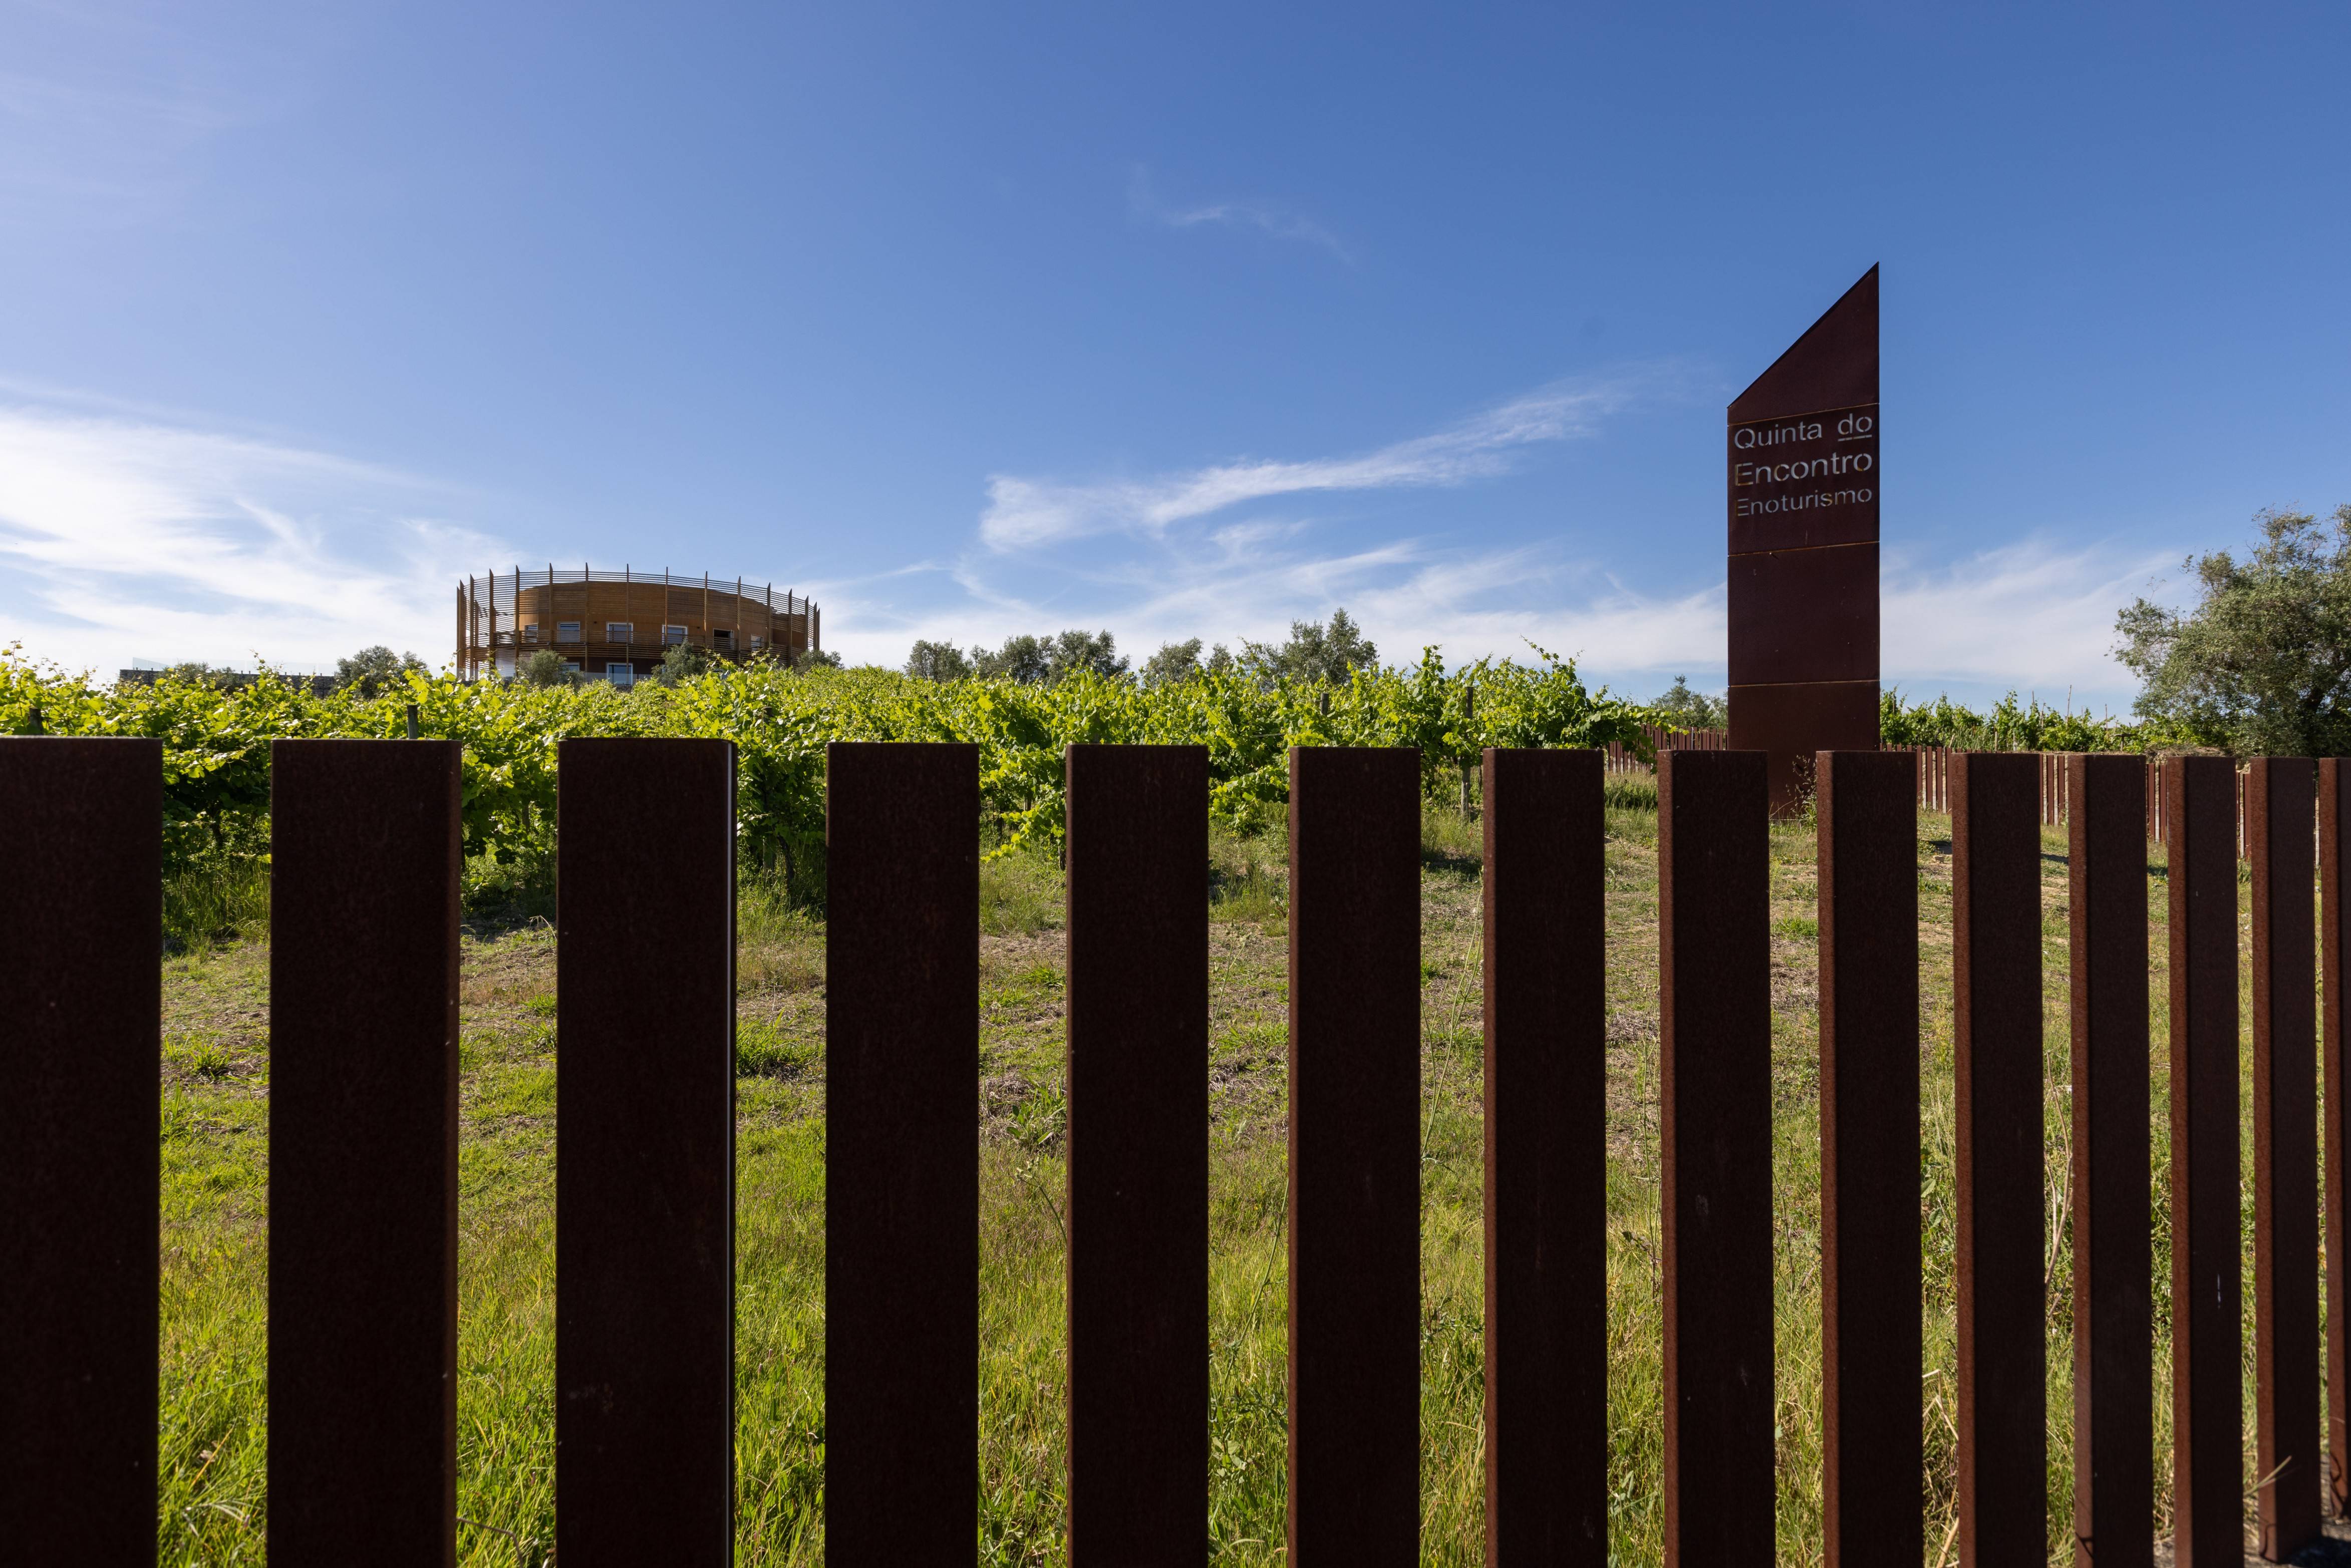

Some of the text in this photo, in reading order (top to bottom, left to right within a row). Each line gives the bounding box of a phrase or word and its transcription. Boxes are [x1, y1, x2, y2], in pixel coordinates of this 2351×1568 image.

[1734, 413, 1872, 449] Quinta do
[1735, 452, 1872, 486] Encontro
[1736, 488, 1872, 516] Enoturismo
